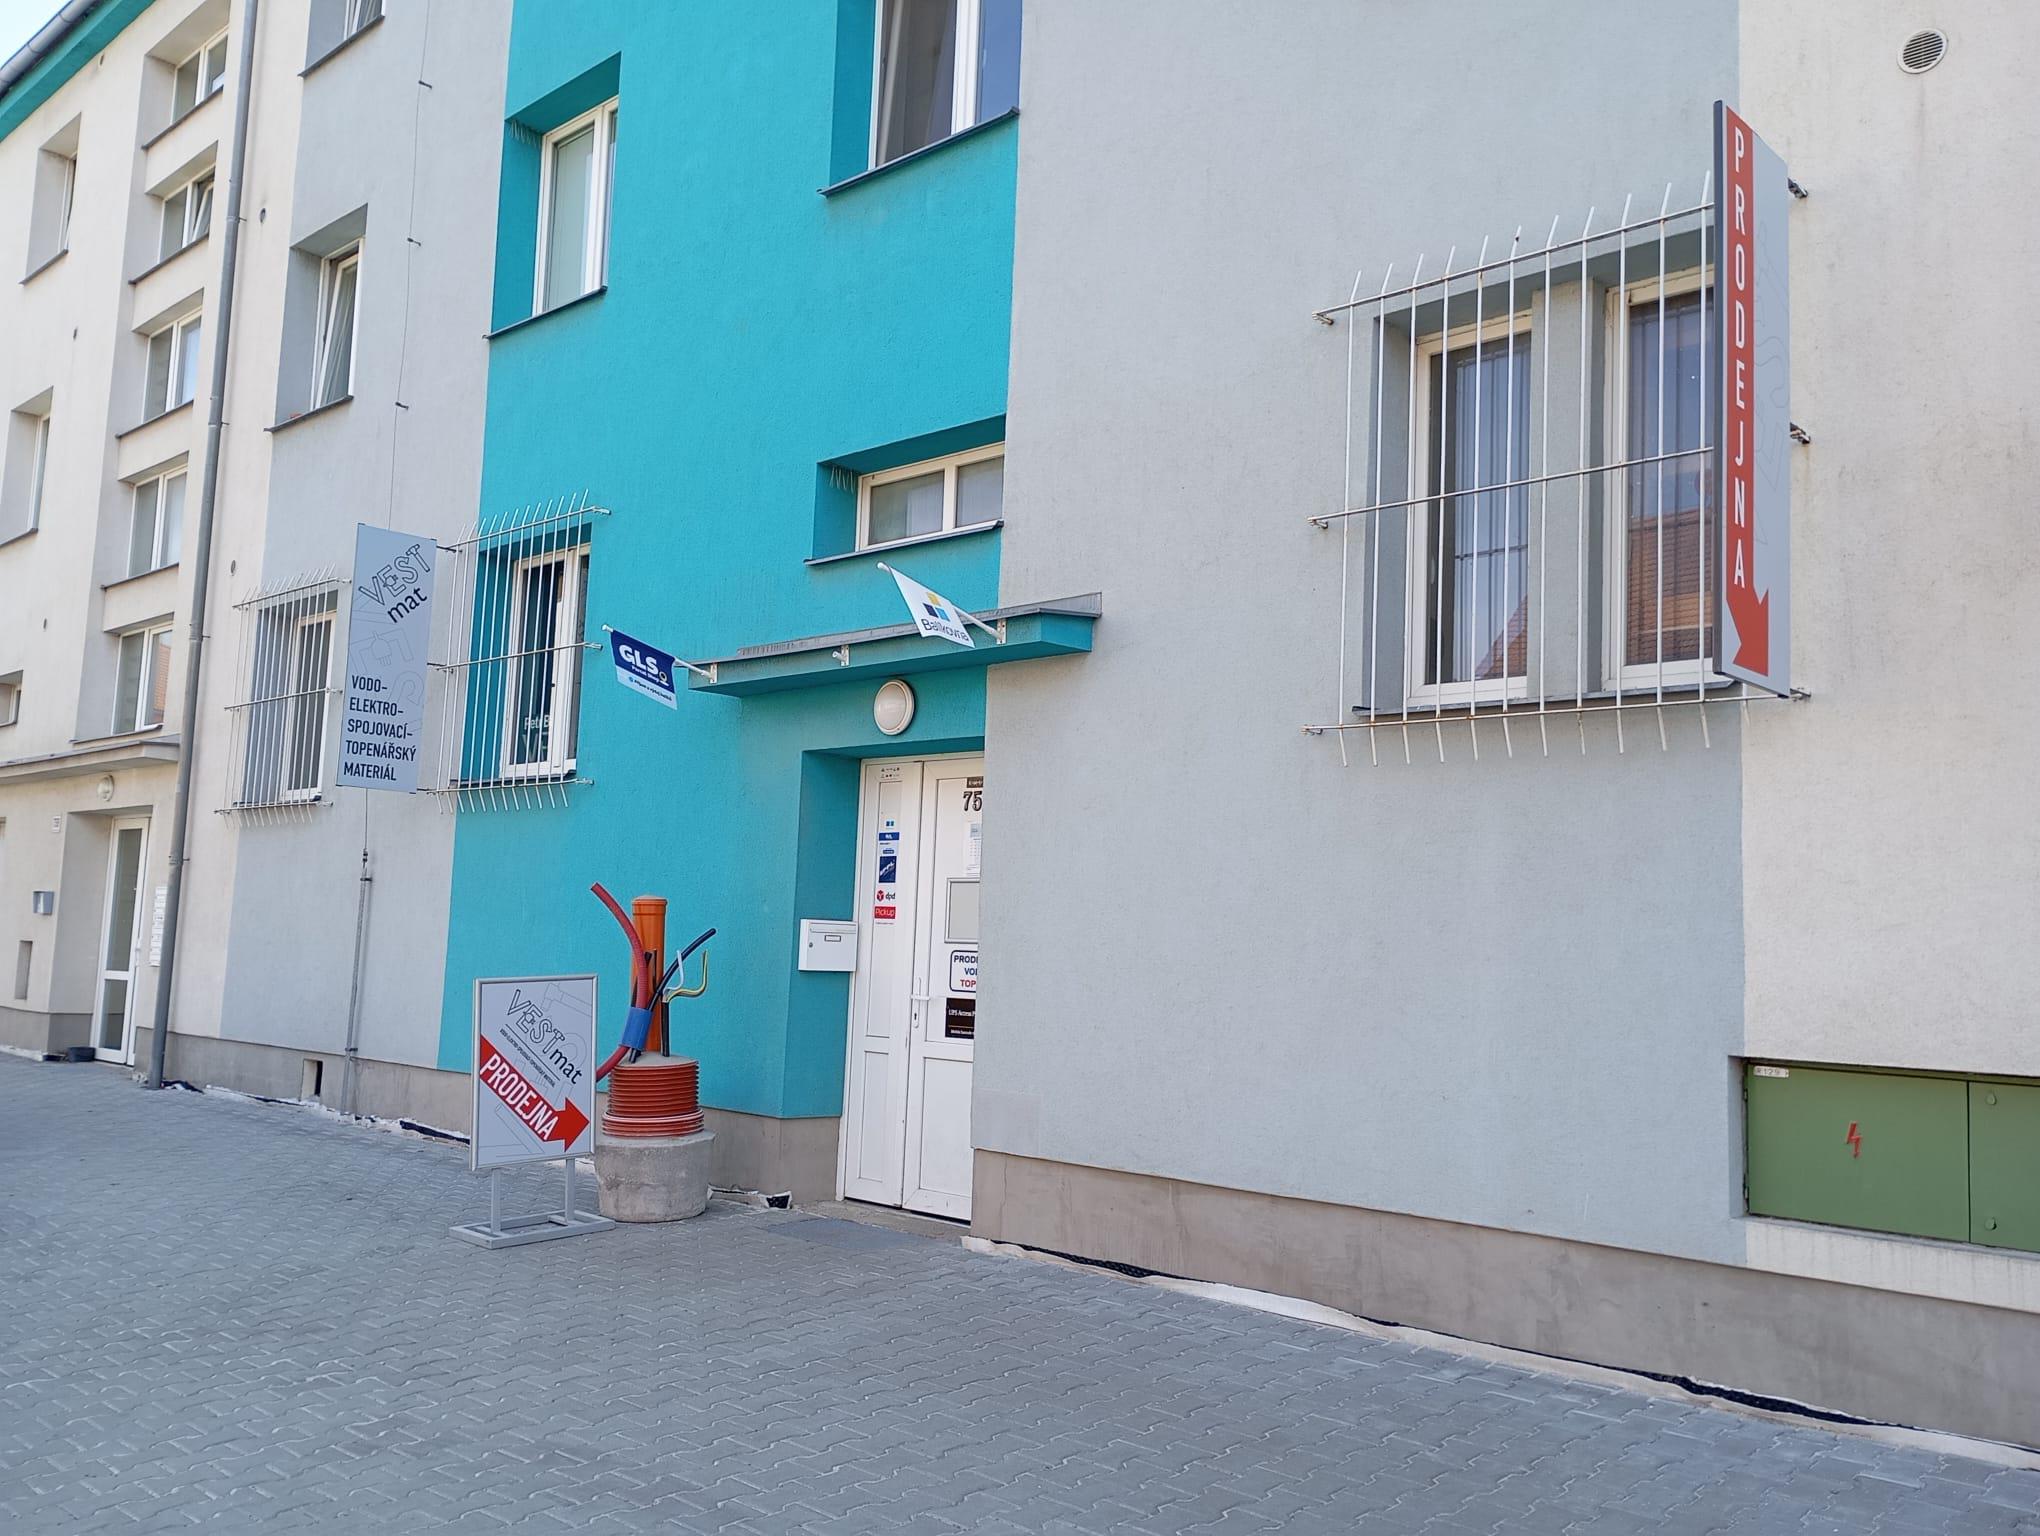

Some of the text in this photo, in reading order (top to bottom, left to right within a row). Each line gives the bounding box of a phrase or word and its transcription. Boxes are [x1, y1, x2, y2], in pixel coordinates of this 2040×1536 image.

[1733, 126, 1747, 588] PRODEJNA
[358, 543, 431, 606] VEST
[387, 587, 428, 623] mat
[618, 644, 660, 675] GLS
[351, 674, 388, 693] VODO-
[349, 696, 404, 717] ELEKTRO-
[347, 718, 414, 740] SPOJOVACÍ-
[345, 739, 417, 762] TOPENÁŘSKÝ
[343, 761, 397, 781] MATERIÁL
[507, 989, 566, 1053] VEST
[549, 1048, 583, 1085] mat
[479, 1053, 560, 1141] PRODEJNA
